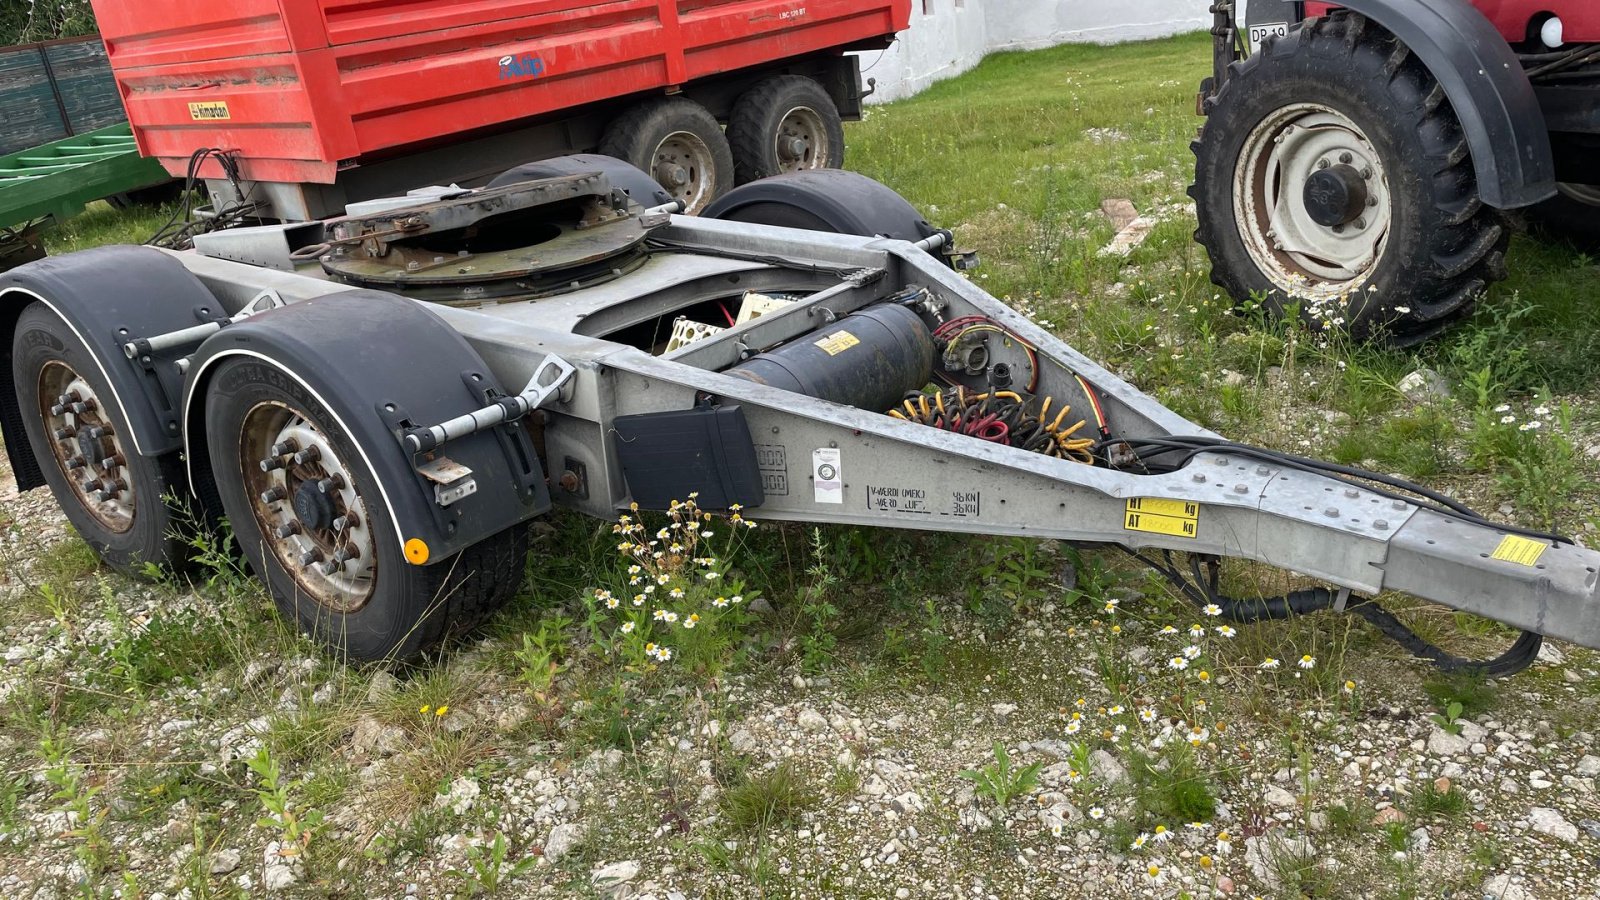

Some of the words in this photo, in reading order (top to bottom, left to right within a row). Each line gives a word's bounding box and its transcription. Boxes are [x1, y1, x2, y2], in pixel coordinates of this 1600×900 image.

[1185, 502, 1196, 516] kg
[1128, 514, 1140, 527] AT
[1183, 521, 1194, 534] kg
